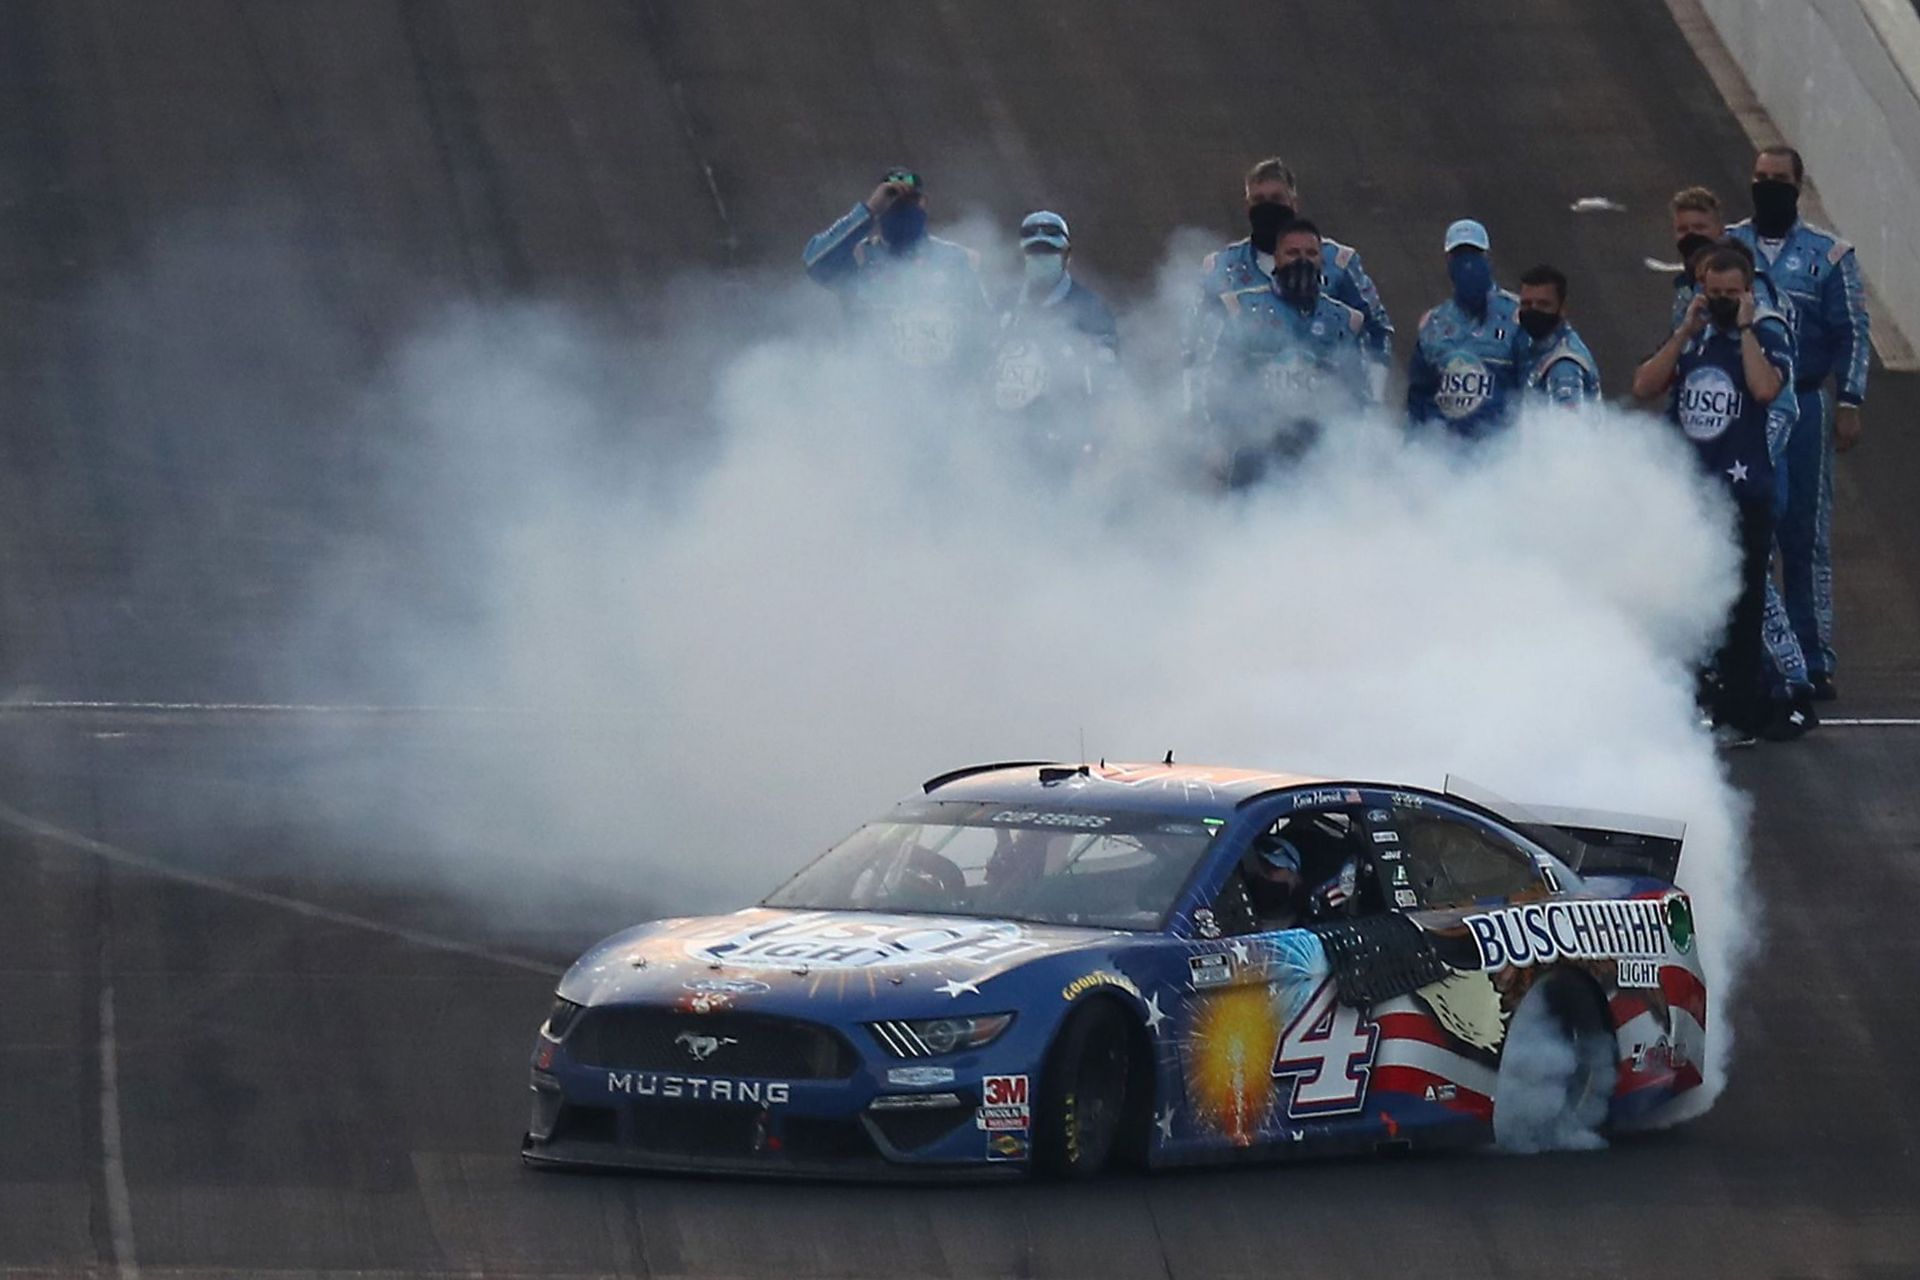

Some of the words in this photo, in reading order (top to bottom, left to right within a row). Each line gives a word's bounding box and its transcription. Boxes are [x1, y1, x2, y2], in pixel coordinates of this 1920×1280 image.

[992, 810, 1036, 823] CUP
[1033, 813, 1112, 828] SERIES
[1466, 902, 1667, 967] BUSCHHHHH
[1619, 961, 1658, 984] LIGHT
[1271, 972, 1380, 1118] 4
[607, 1071, 790, 1103] MUSTANG
[986, 1077, 1026, 1105] 3M
